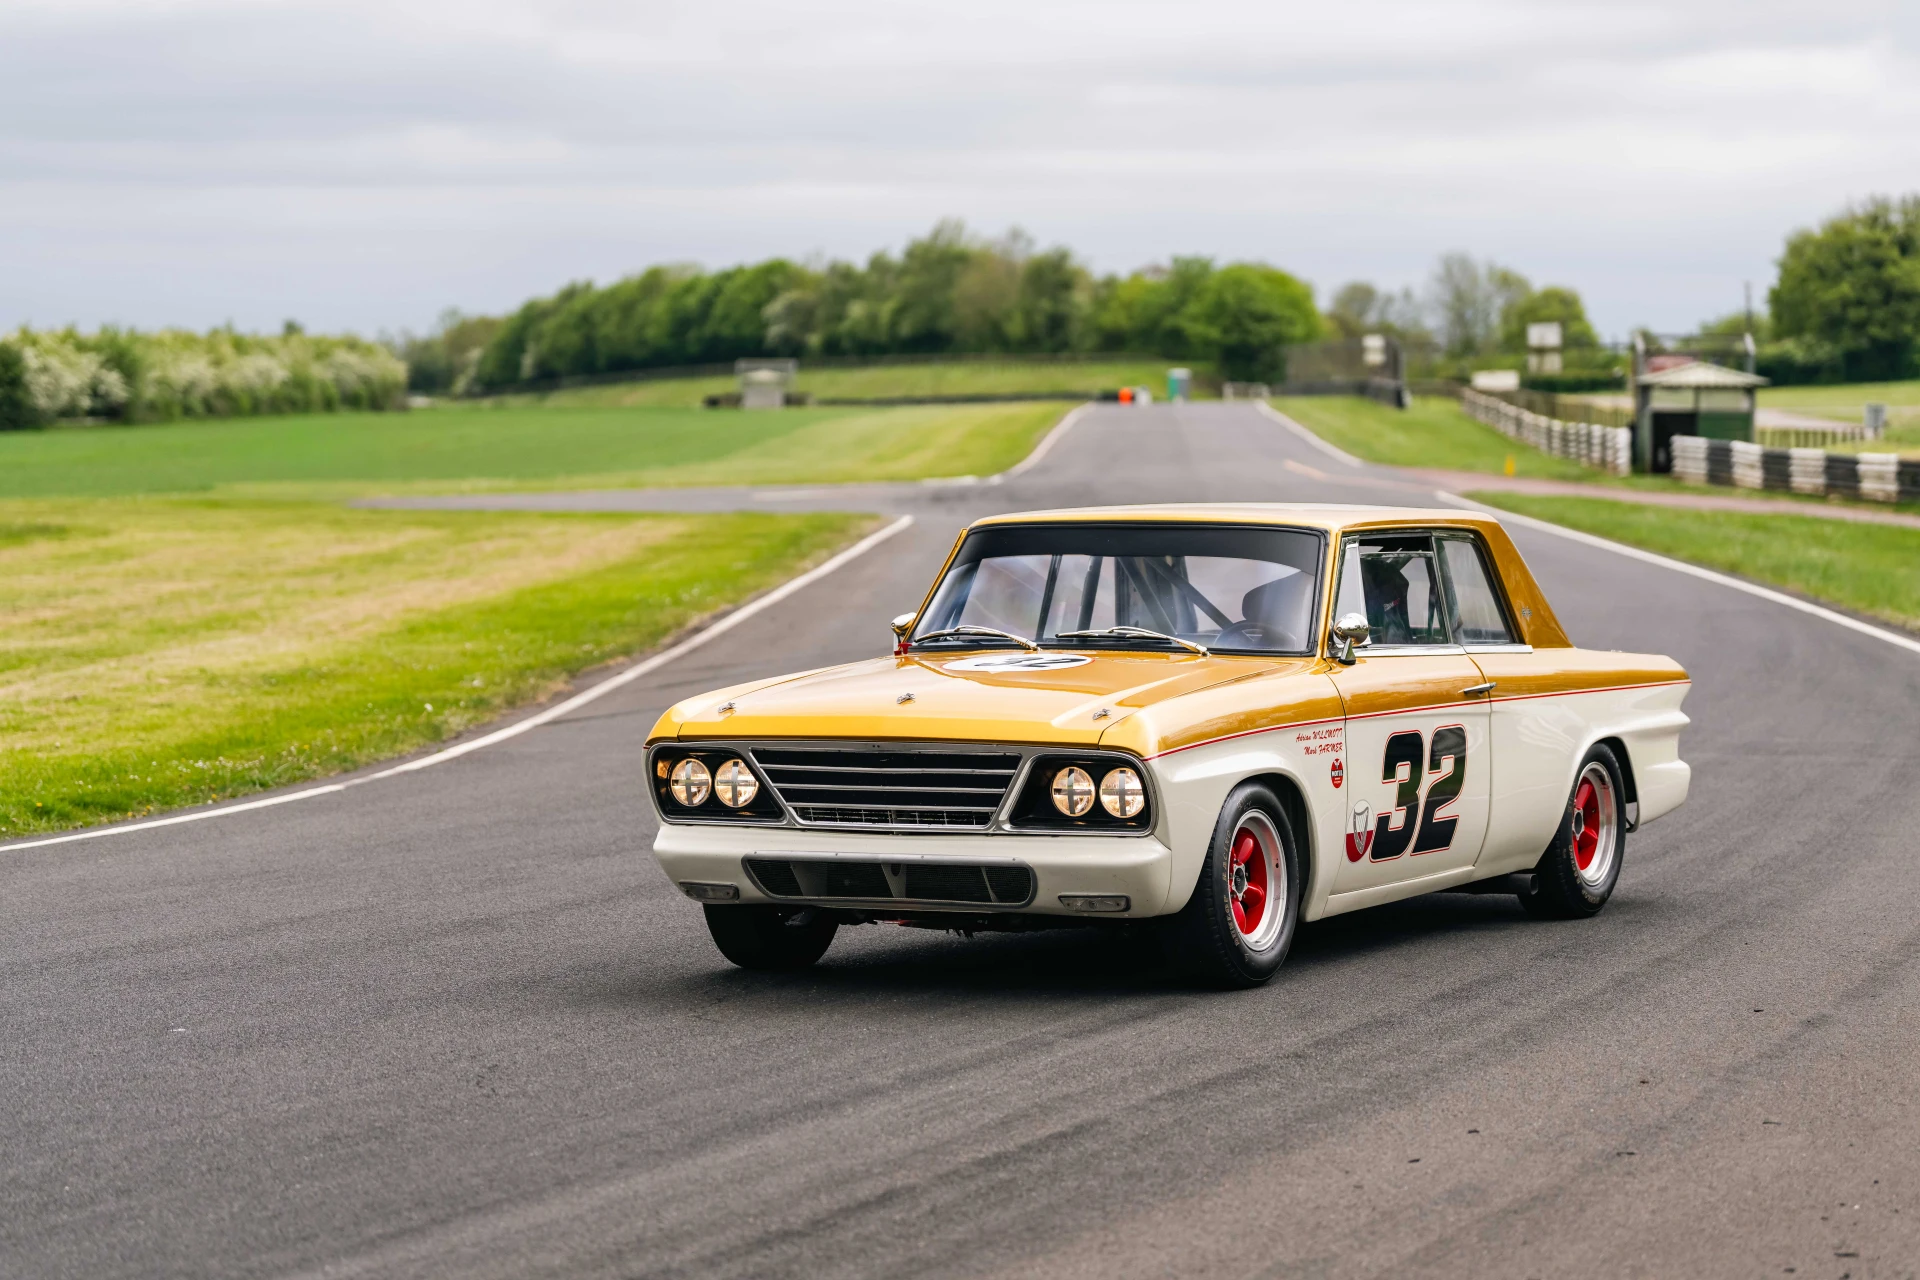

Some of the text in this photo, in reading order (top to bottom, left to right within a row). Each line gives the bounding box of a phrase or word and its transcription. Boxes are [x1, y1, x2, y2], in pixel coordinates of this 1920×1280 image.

[975, 656, 1087, 668] 32
[1313, 728, 1343, 740] WILLMOTT
[1304, 746, 1317, 755] Mark
[1369, 723, 1468, 864] 32
